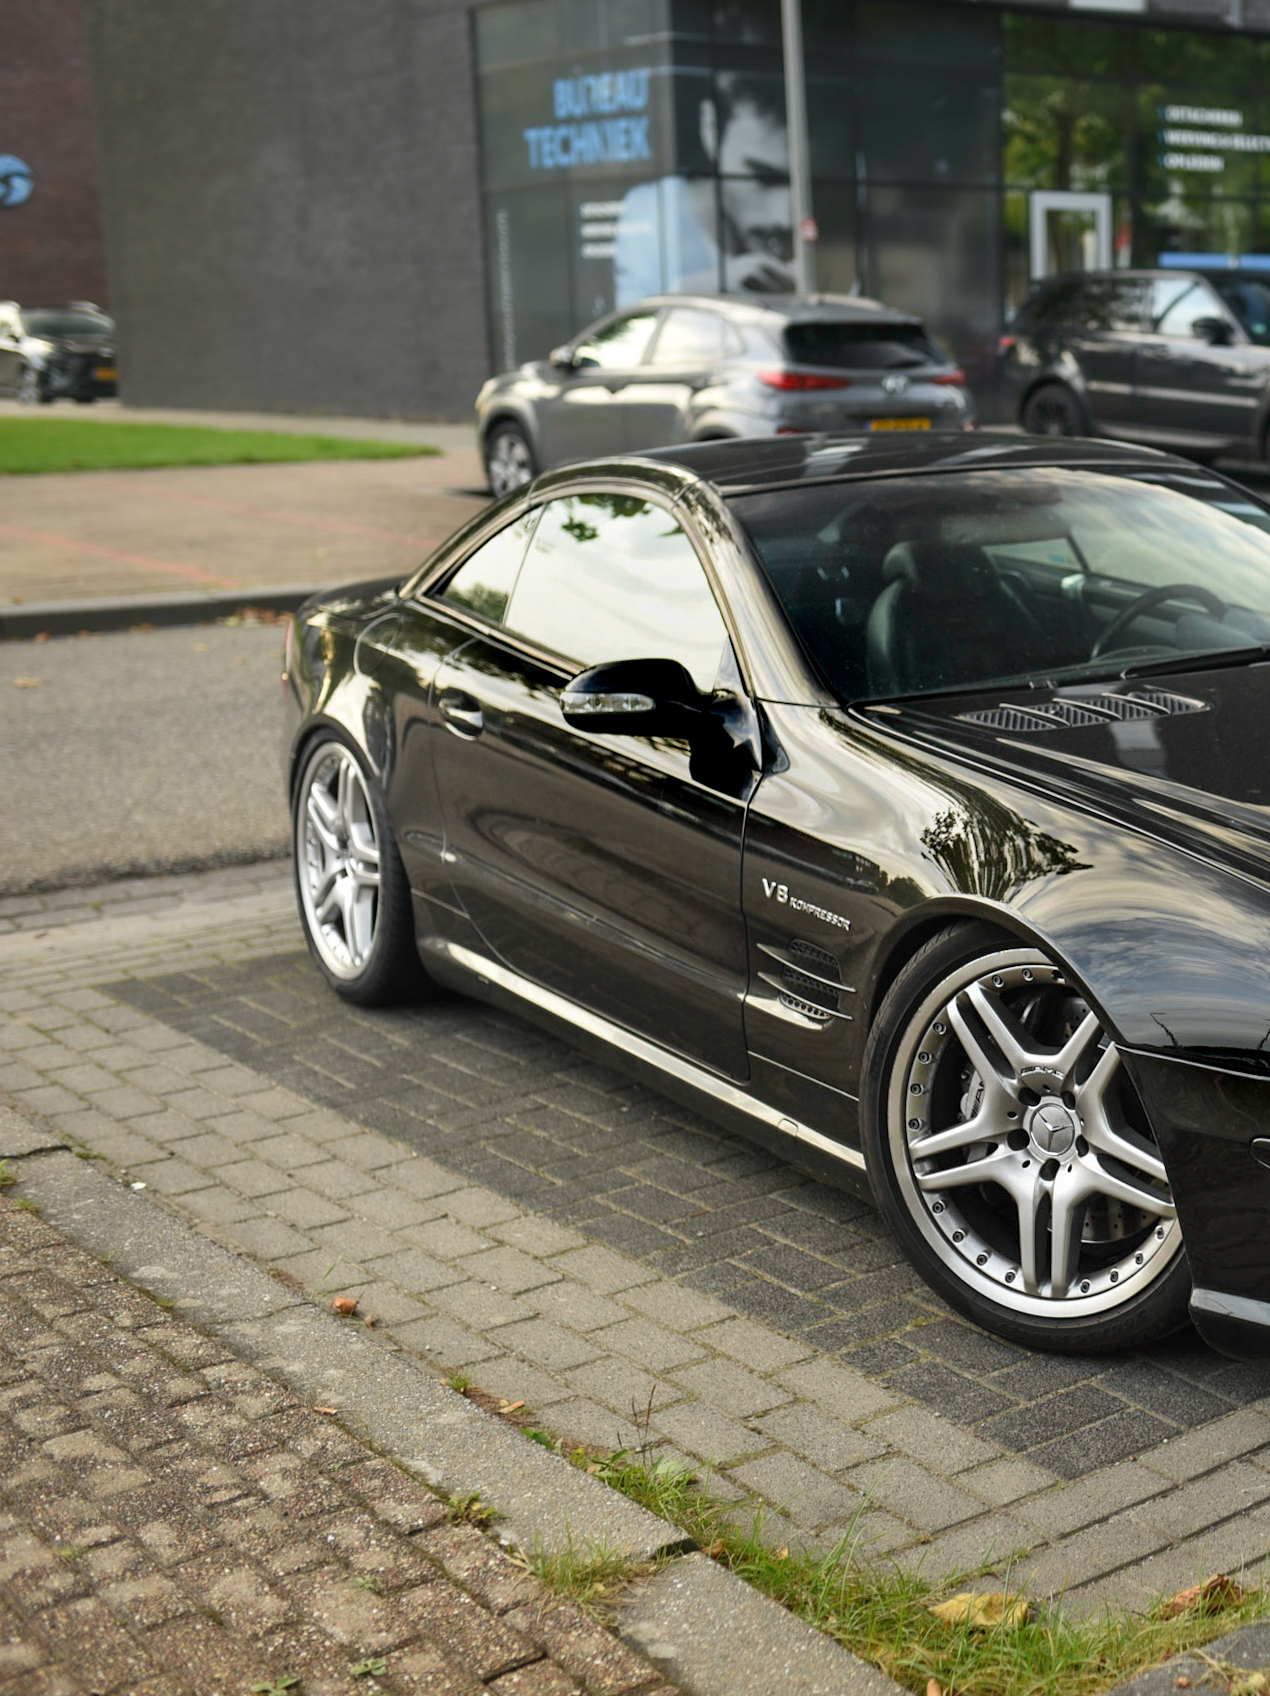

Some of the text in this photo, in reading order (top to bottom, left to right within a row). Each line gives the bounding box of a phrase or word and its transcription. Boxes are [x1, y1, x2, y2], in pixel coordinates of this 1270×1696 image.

[553, 67, 650, 120] BUREAU
[523, 114, 652, 171] TECHNIEK
[761, 878, 852, 932] V8 KOMPRESSOR
